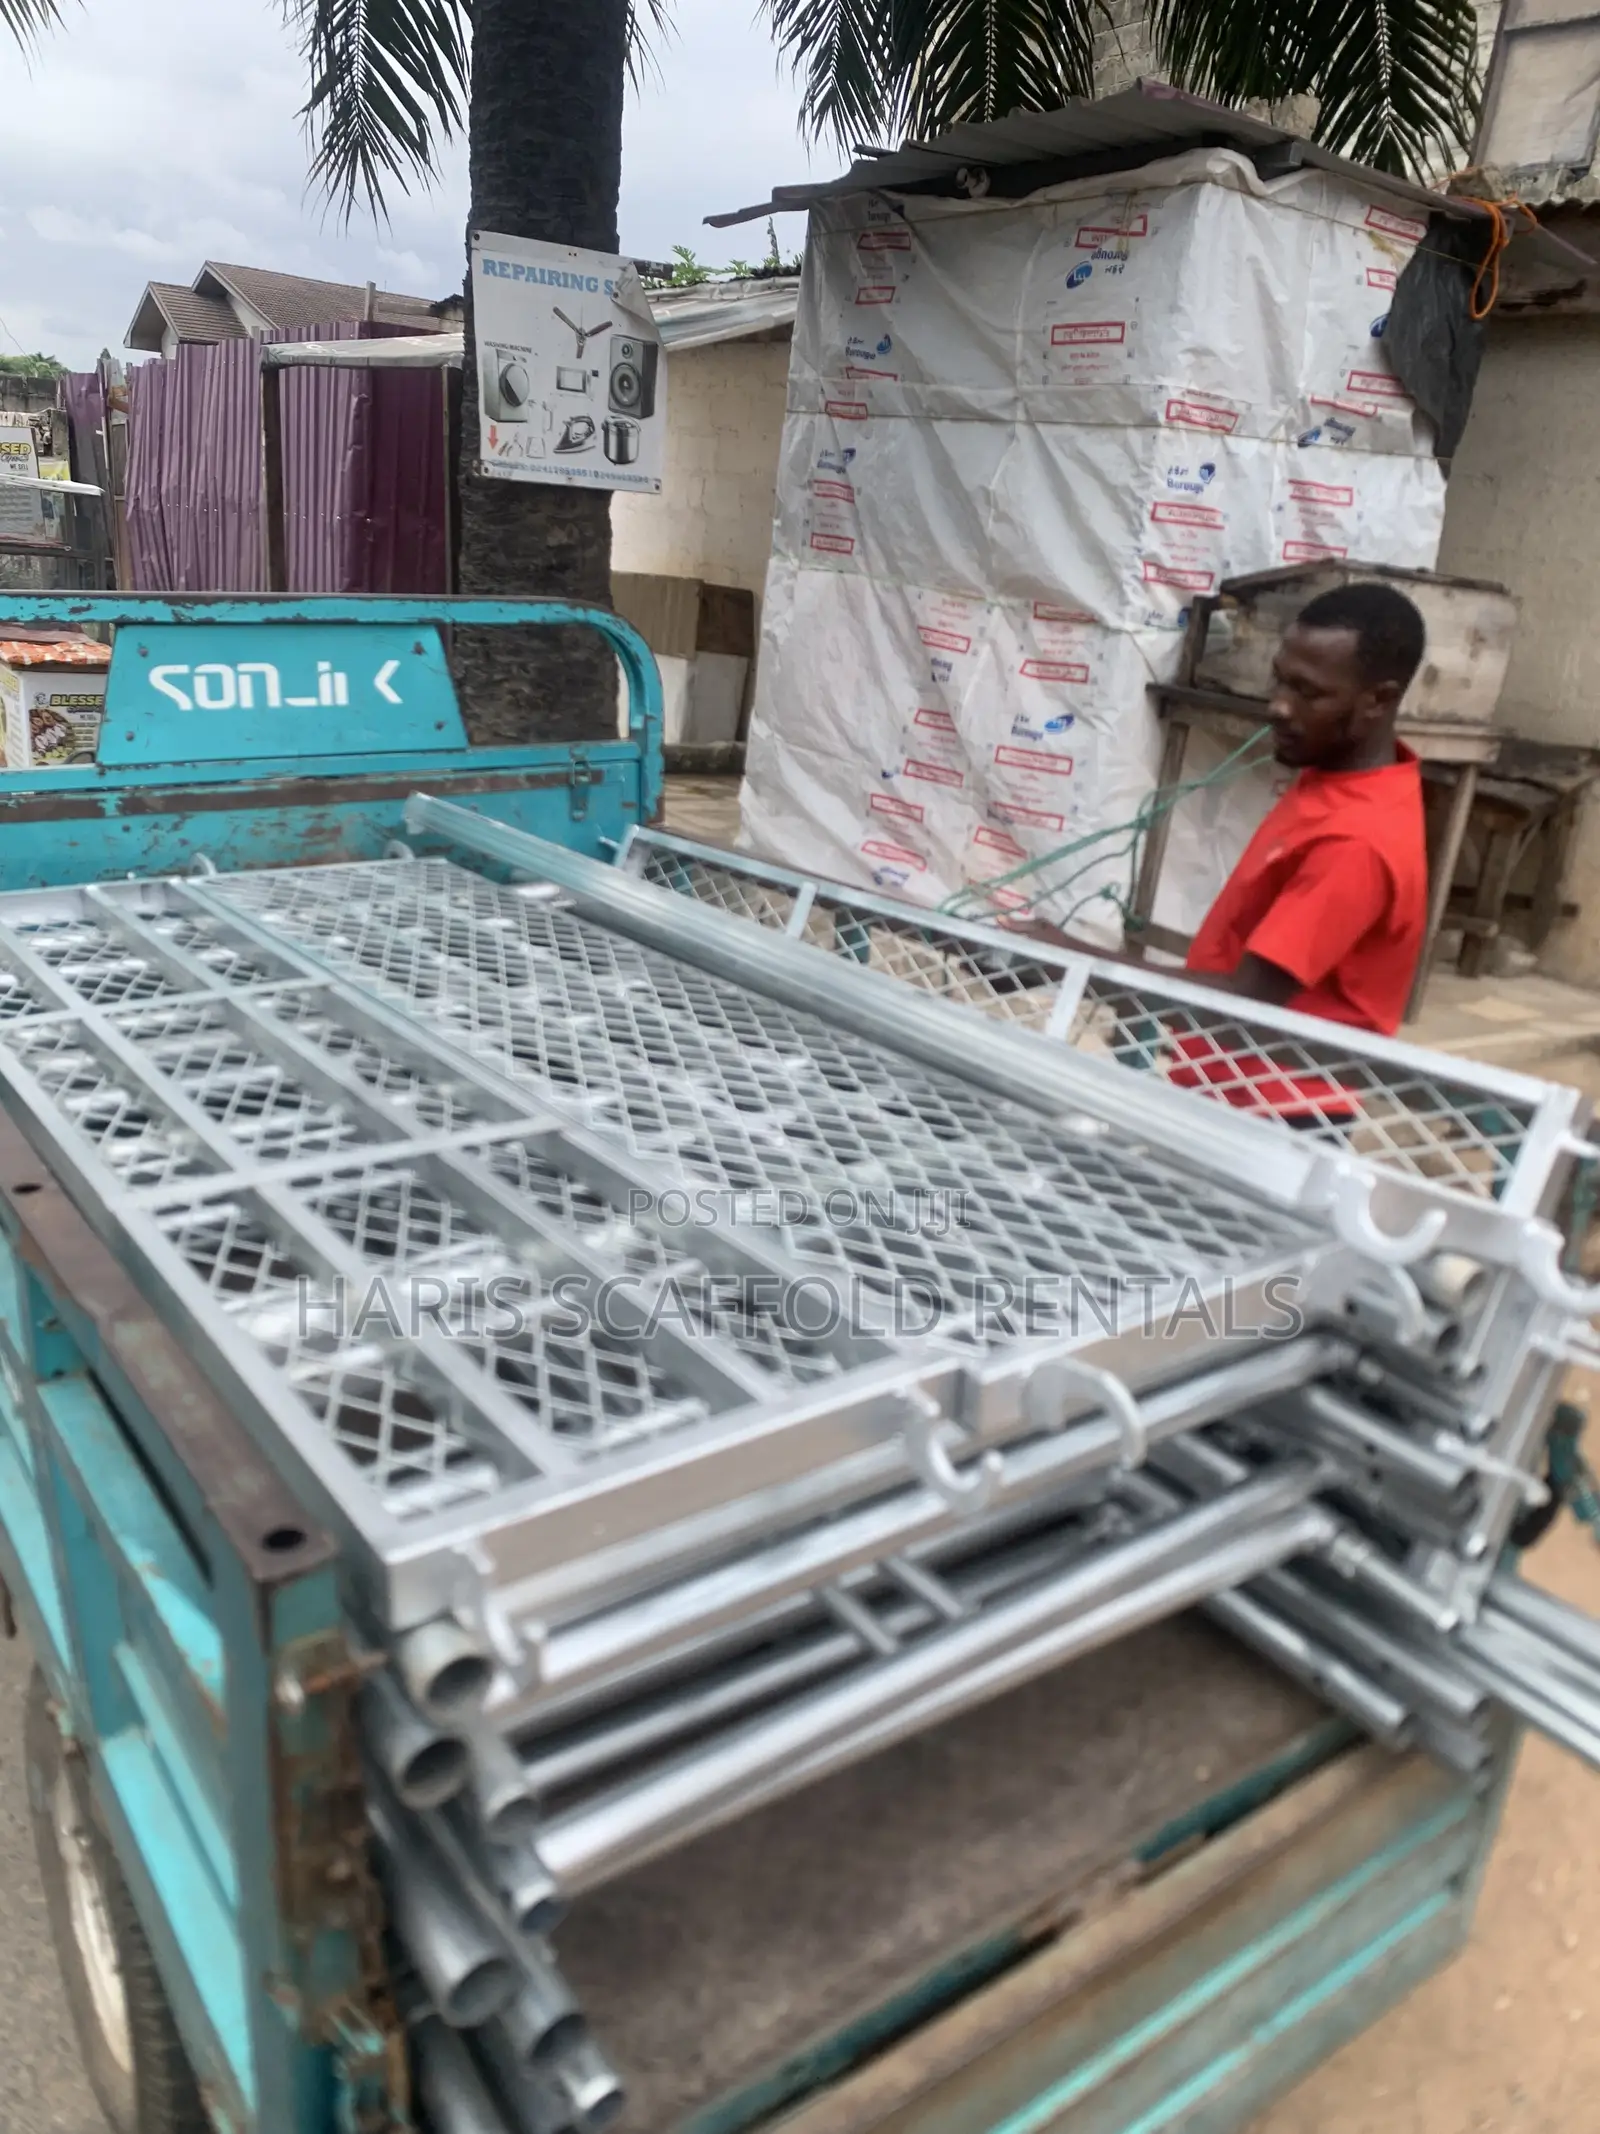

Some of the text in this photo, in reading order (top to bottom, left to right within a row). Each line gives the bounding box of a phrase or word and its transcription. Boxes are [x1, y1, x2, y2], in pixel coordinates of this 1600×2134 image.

[482, 259, 618, 296] REPAIRING S
[50, 694, 105, 706] BLESSE
